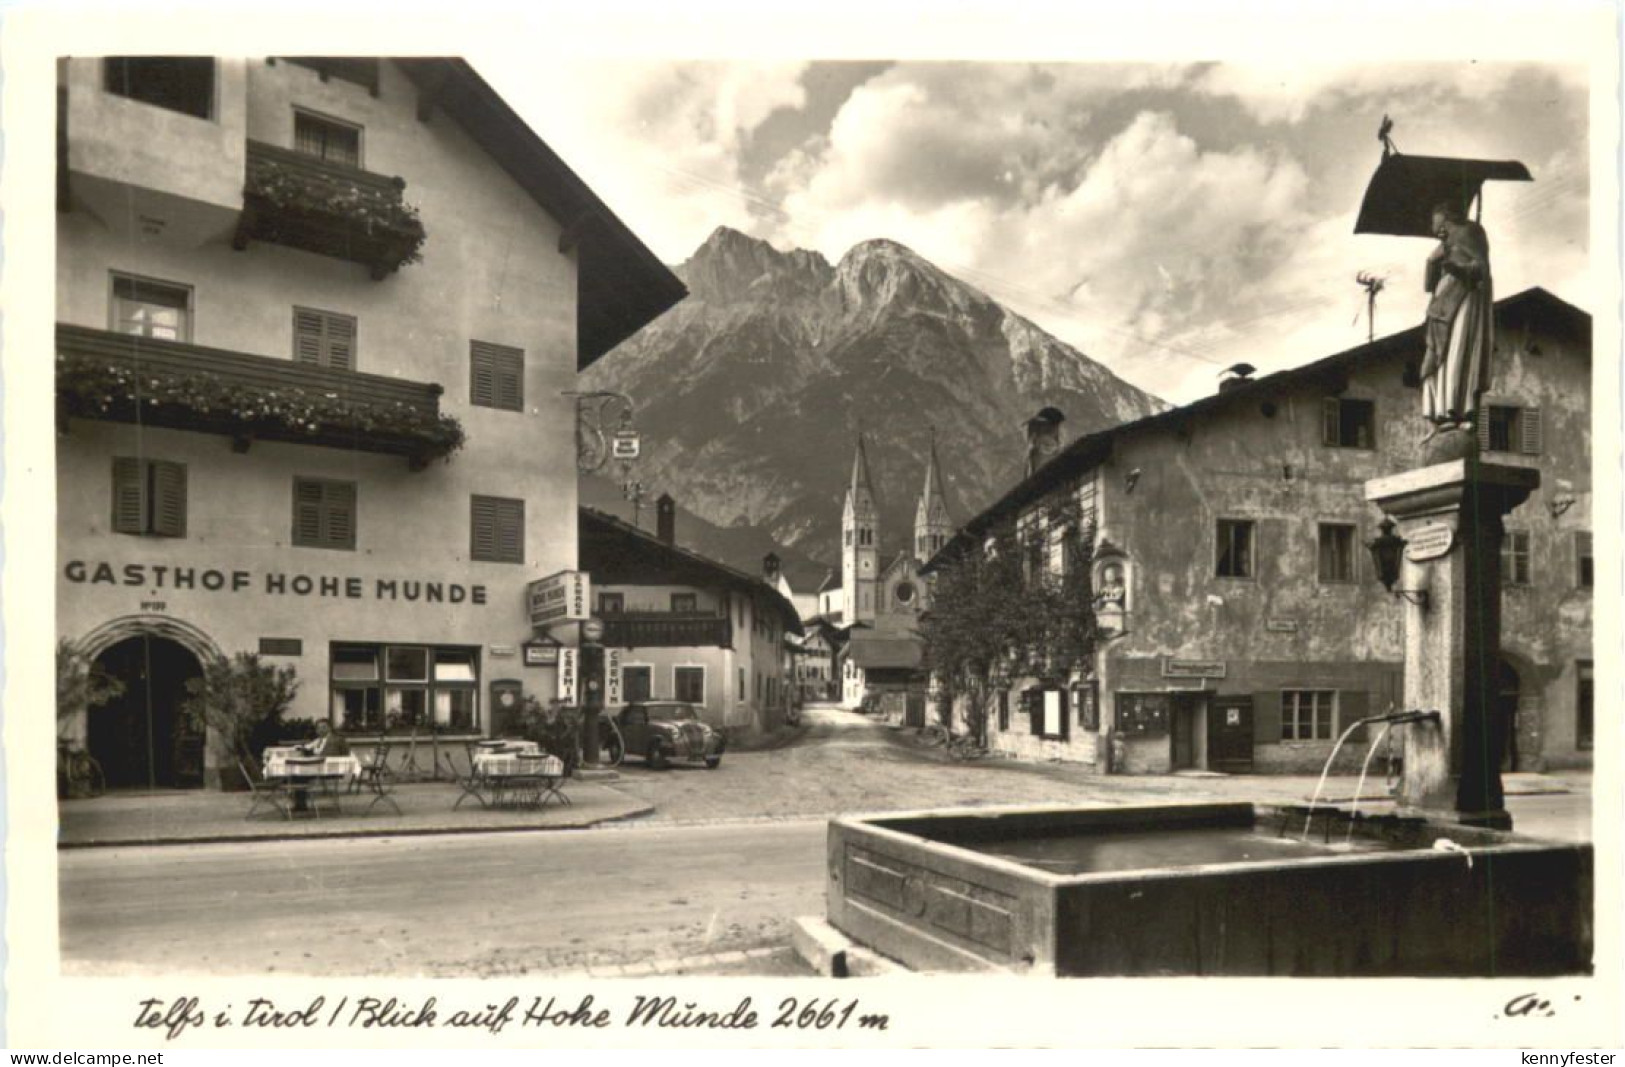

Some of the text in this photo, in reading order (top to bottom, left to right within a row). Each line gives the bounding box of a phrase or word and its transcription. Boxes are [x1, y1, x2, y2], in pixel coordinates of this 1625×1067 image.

[63, 559, 487, 606] GASTHOF HOHE MUNDE
[133, 996, 205, 1041] Telfs
[242, 995, 325, 1028] Tirol
[349, 996, 438, 1029] Blick
[522, 994, 611, 1029] Hohe
[626, 995, 759, 1029] Munde
[771, 996, 860, 1030] 2661
[859, 1012, 890, 1031] m
